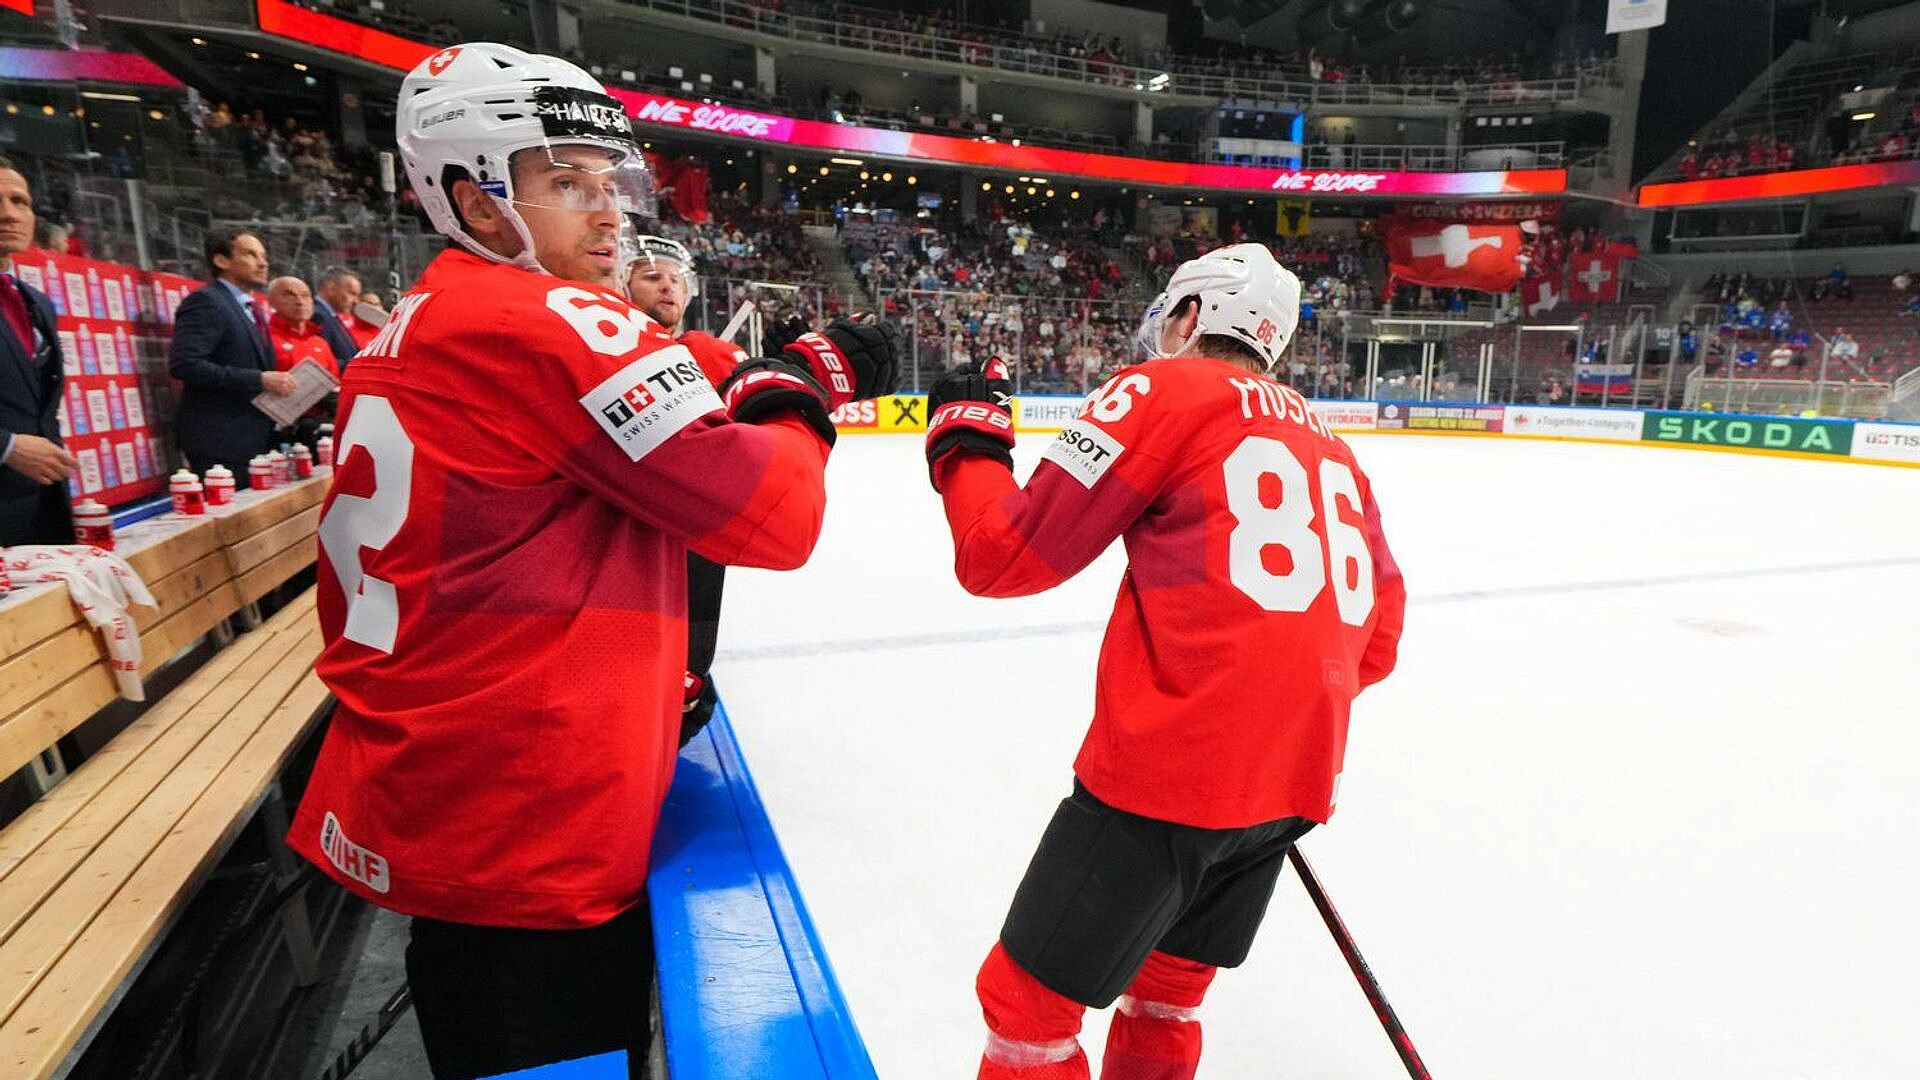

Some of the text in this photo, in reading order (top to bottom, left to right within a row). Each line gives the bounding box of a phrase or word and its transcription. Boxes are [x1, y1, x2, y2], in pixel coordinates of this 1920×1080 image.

[421, 109, 465, 129] BAUER
[638, 100, 778, 137] WE SCORE
[1272, 172, 1387, 192] WE SCORE
[1256, 318, 1278, 346] 86
[623, 411, 660, 441] SWISS
[1222, 435, 1375, 628] 86
[331, 829, 381, 884] IIHF
